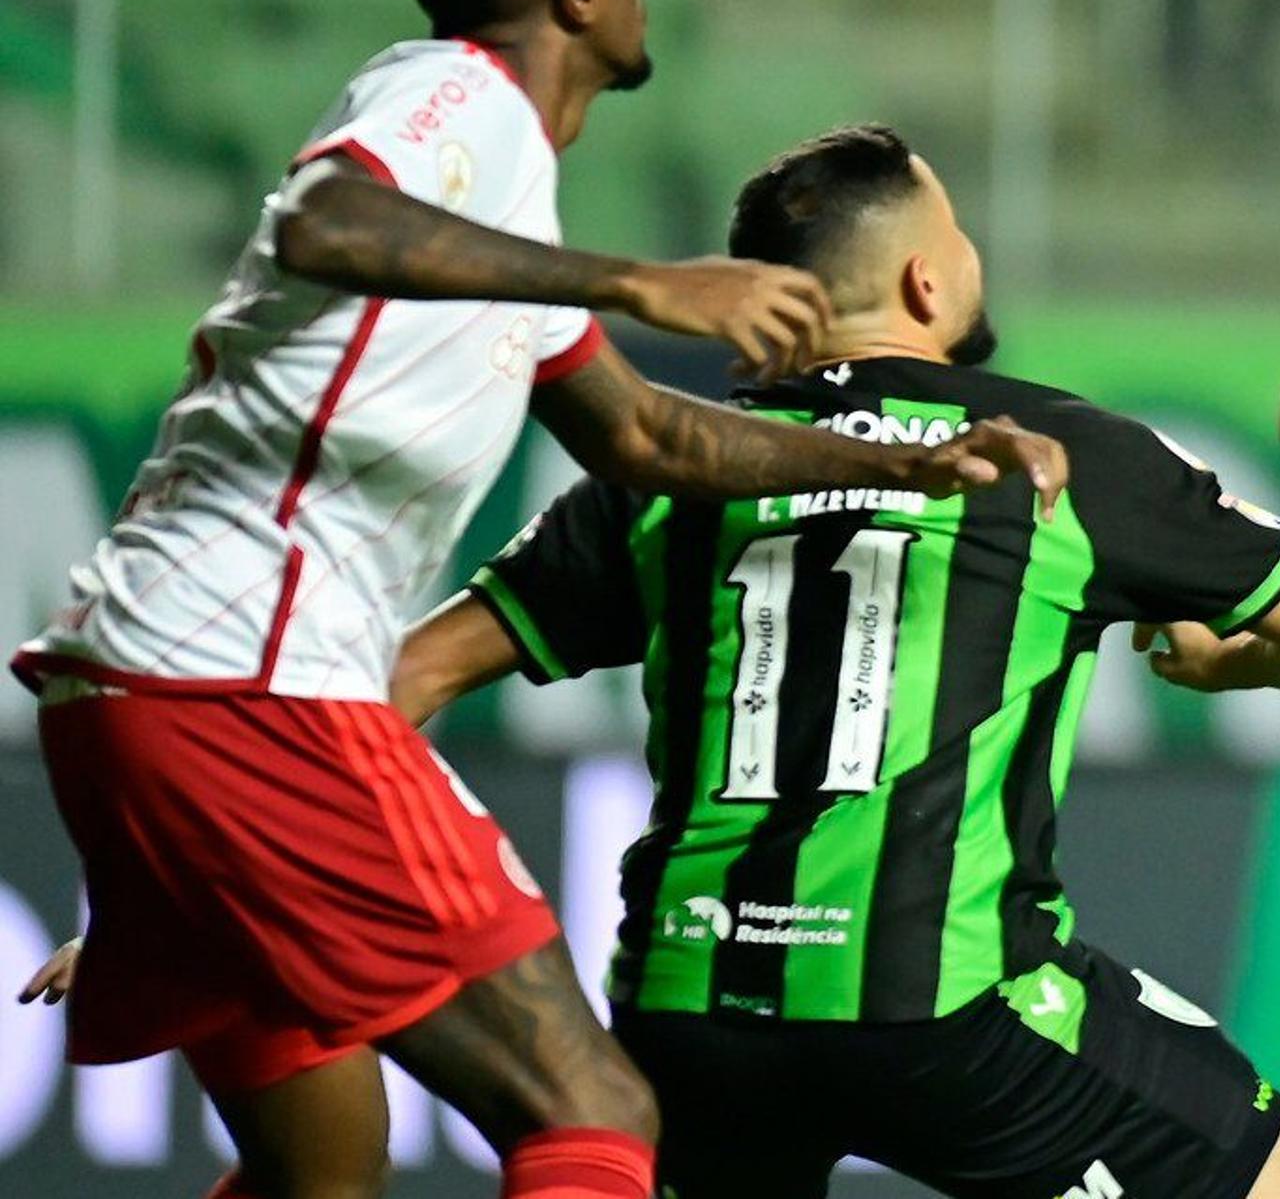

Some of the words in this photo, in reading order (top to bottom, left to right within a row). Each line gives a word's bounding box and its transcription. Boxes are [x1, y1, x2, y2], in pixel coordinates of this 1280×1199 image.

[720, 528, 918, 799] 11
[752, 606, 772, 686] hapvido
[856, 602, 879, 684] hapvido
[738, 901, 822, 924] Hospital
